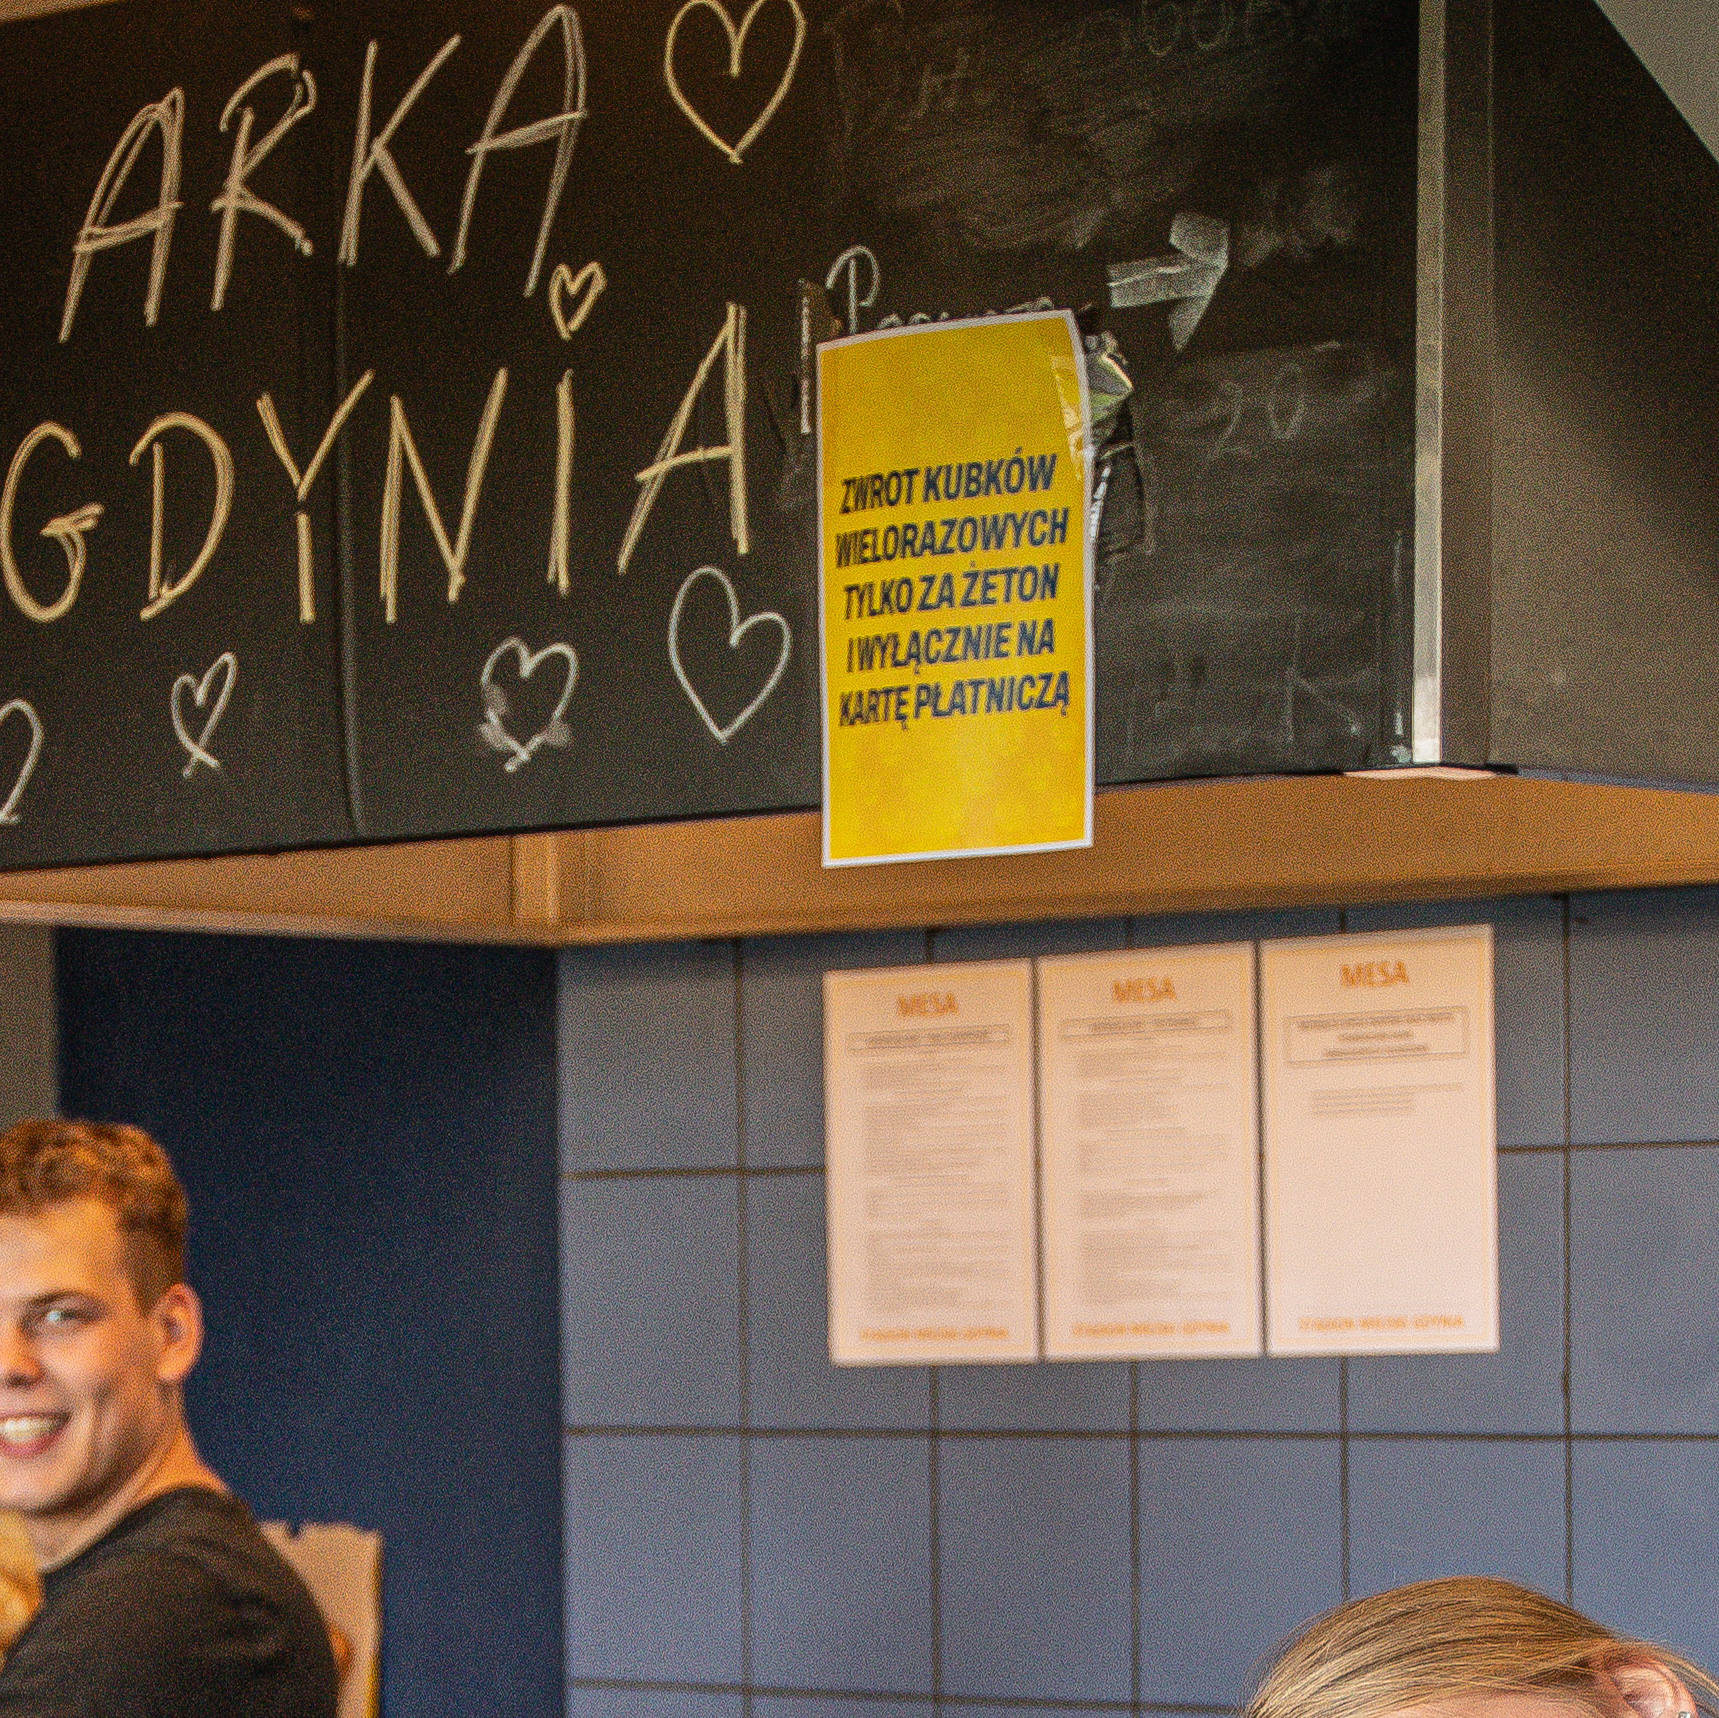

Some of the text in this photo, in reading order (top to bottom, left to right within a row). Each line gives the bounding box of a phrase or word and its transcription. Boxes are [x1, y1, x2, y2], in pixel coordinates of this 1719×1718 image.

[58, 3, 588, 343] ARKA
[839, 447, 1058, 515] ZWROT KUBKÓW
[836, 507, 1069, 568] WIELORAZOWYCH
[844, 560, 1060, 620] TYLKO ZA ŻETON
[858, 622, 1012, 674] WYŁĄCZNIE
[1016, 617, 1055, 657] NA
[839, 670, 1070, 731] KARTĘ PŁATNICZĄ
[1339, 960, 1409, 989] MESA
